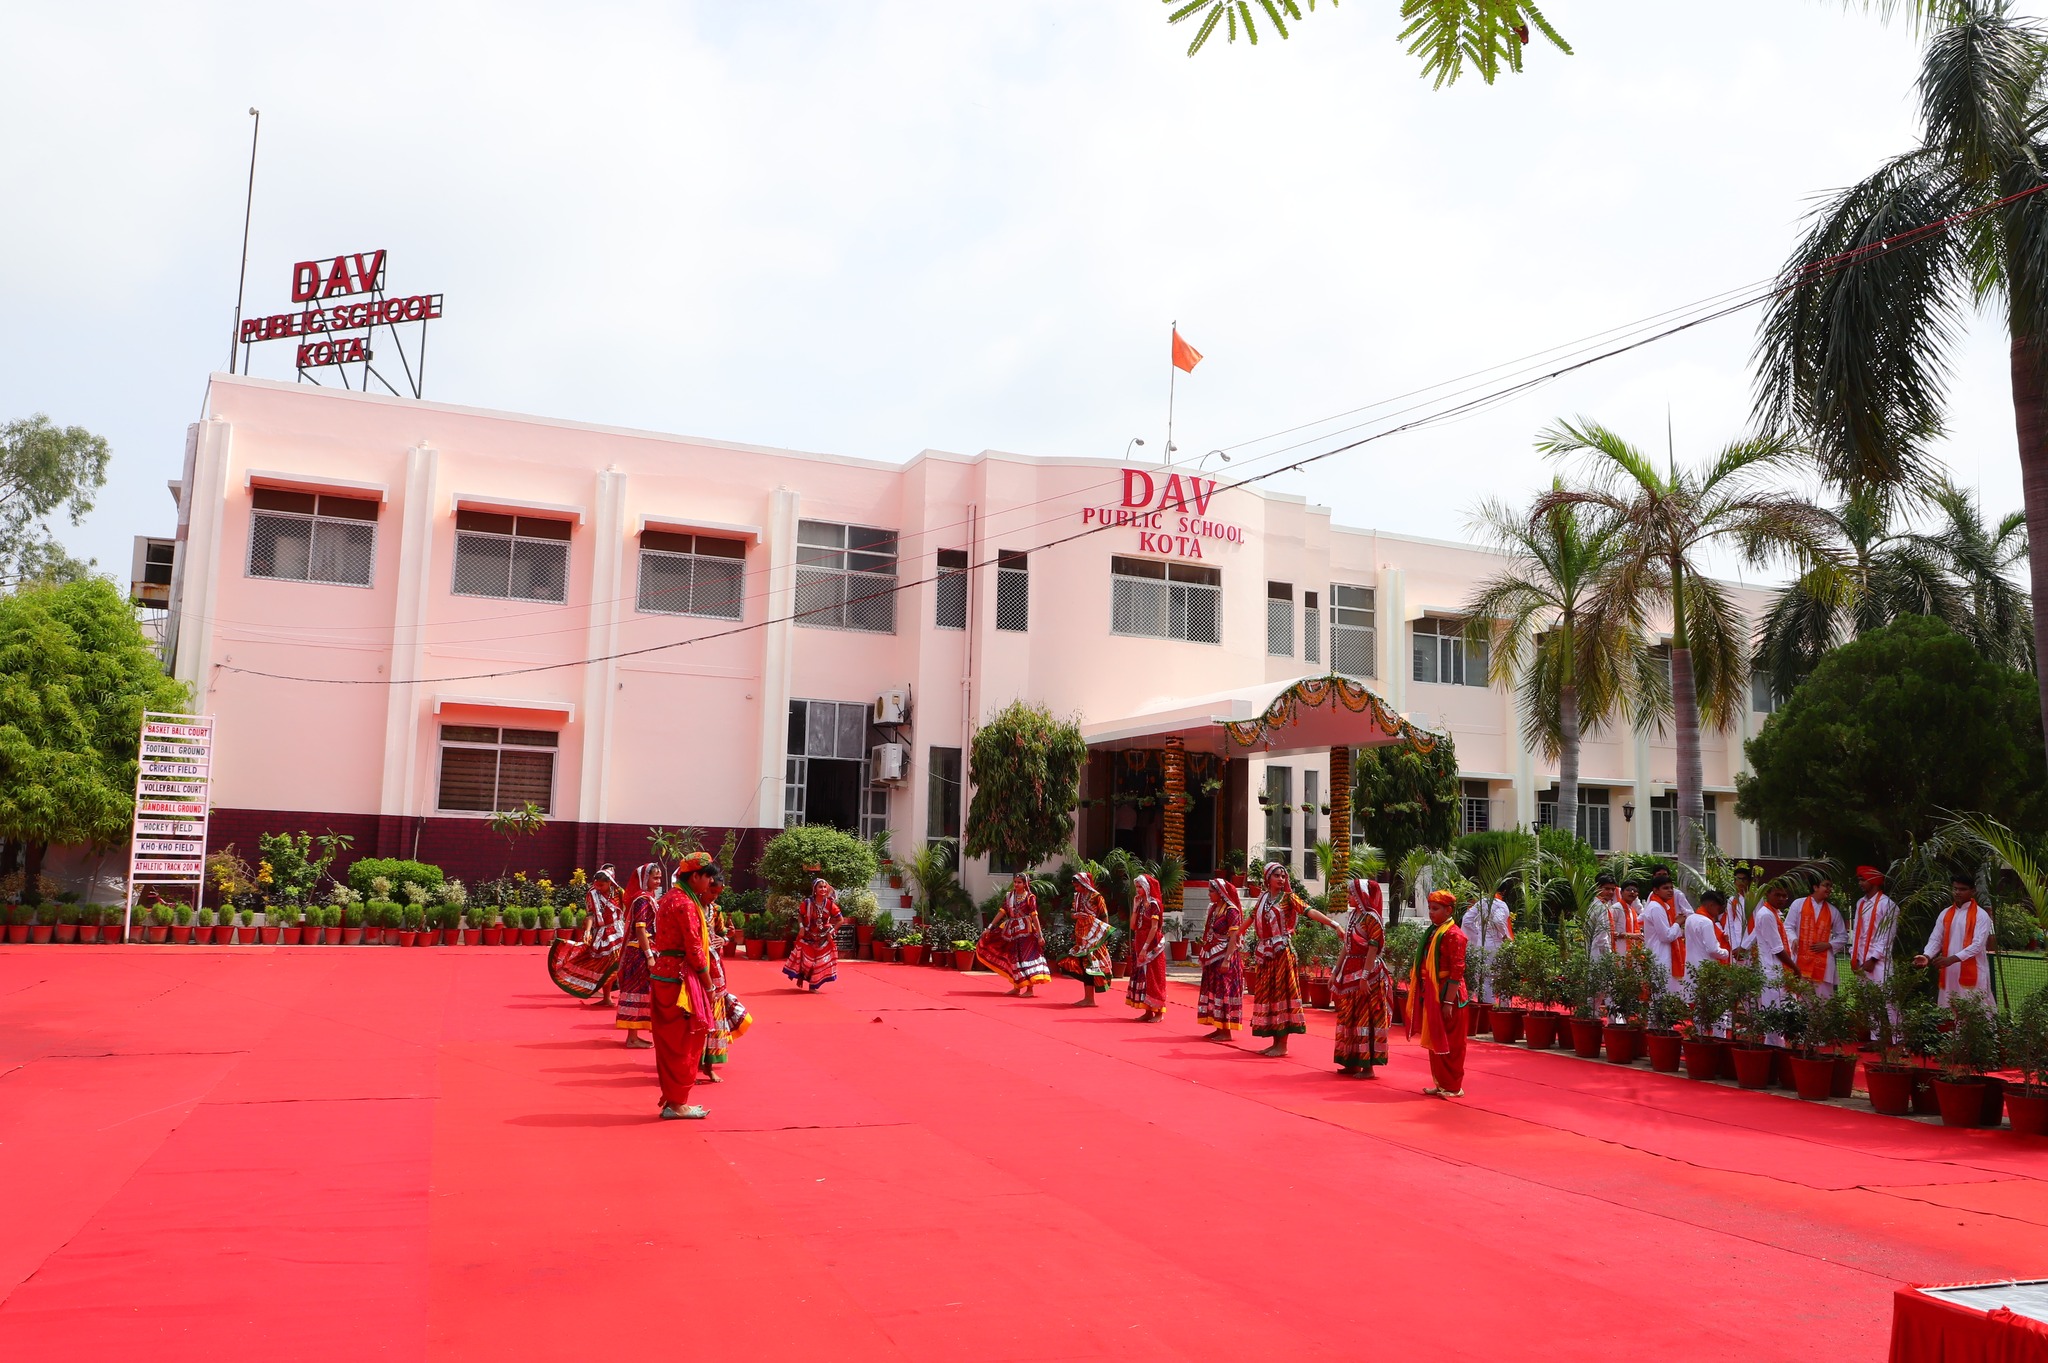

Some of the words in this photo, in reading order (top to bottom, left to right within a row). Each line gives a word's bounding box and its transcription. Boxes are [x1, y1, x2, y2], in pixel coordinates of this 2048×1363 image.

[292, 249, 386, 303] DAV
[240, 309, 325, 343] PUBLIC
[331, 295, 439, 330] SCHOOL
[296, 337, 367, 368] KOTA
[1121, 468, 1217, 516] DAV
[1082, 507, 1163, 530] PUBLIC
[1178, 516, 1245, 545] SCHOOL
[1139, 531, 1203, 559] KOTA
[148, 725, 170, 734] BASKET
[171, 726, 186, 735] BALL
[188, 728, 208, 737] COURT
[146, 744, 175, 754] FOOTBALL
[178, 746, 206, 756] GROUND
[149, 764, 175, 773] CRICKET
[177, 765, 198, 775] FIELD
[144, 783, 181, 793] VOLLEYBALL
[183, 785, 202, 794] COURT
[177, 804, 202, 814] GROUND
[144, 822, 169, 831] HOCKEY
[141, 842, 173, 851] KHO-KHO
[174, 843, 195, 852] FIELD
[135, 862, 163, 871] ATHLETIC
[164, 863, 181, 872] TRACK
[182, 863, 194, 872] 200
